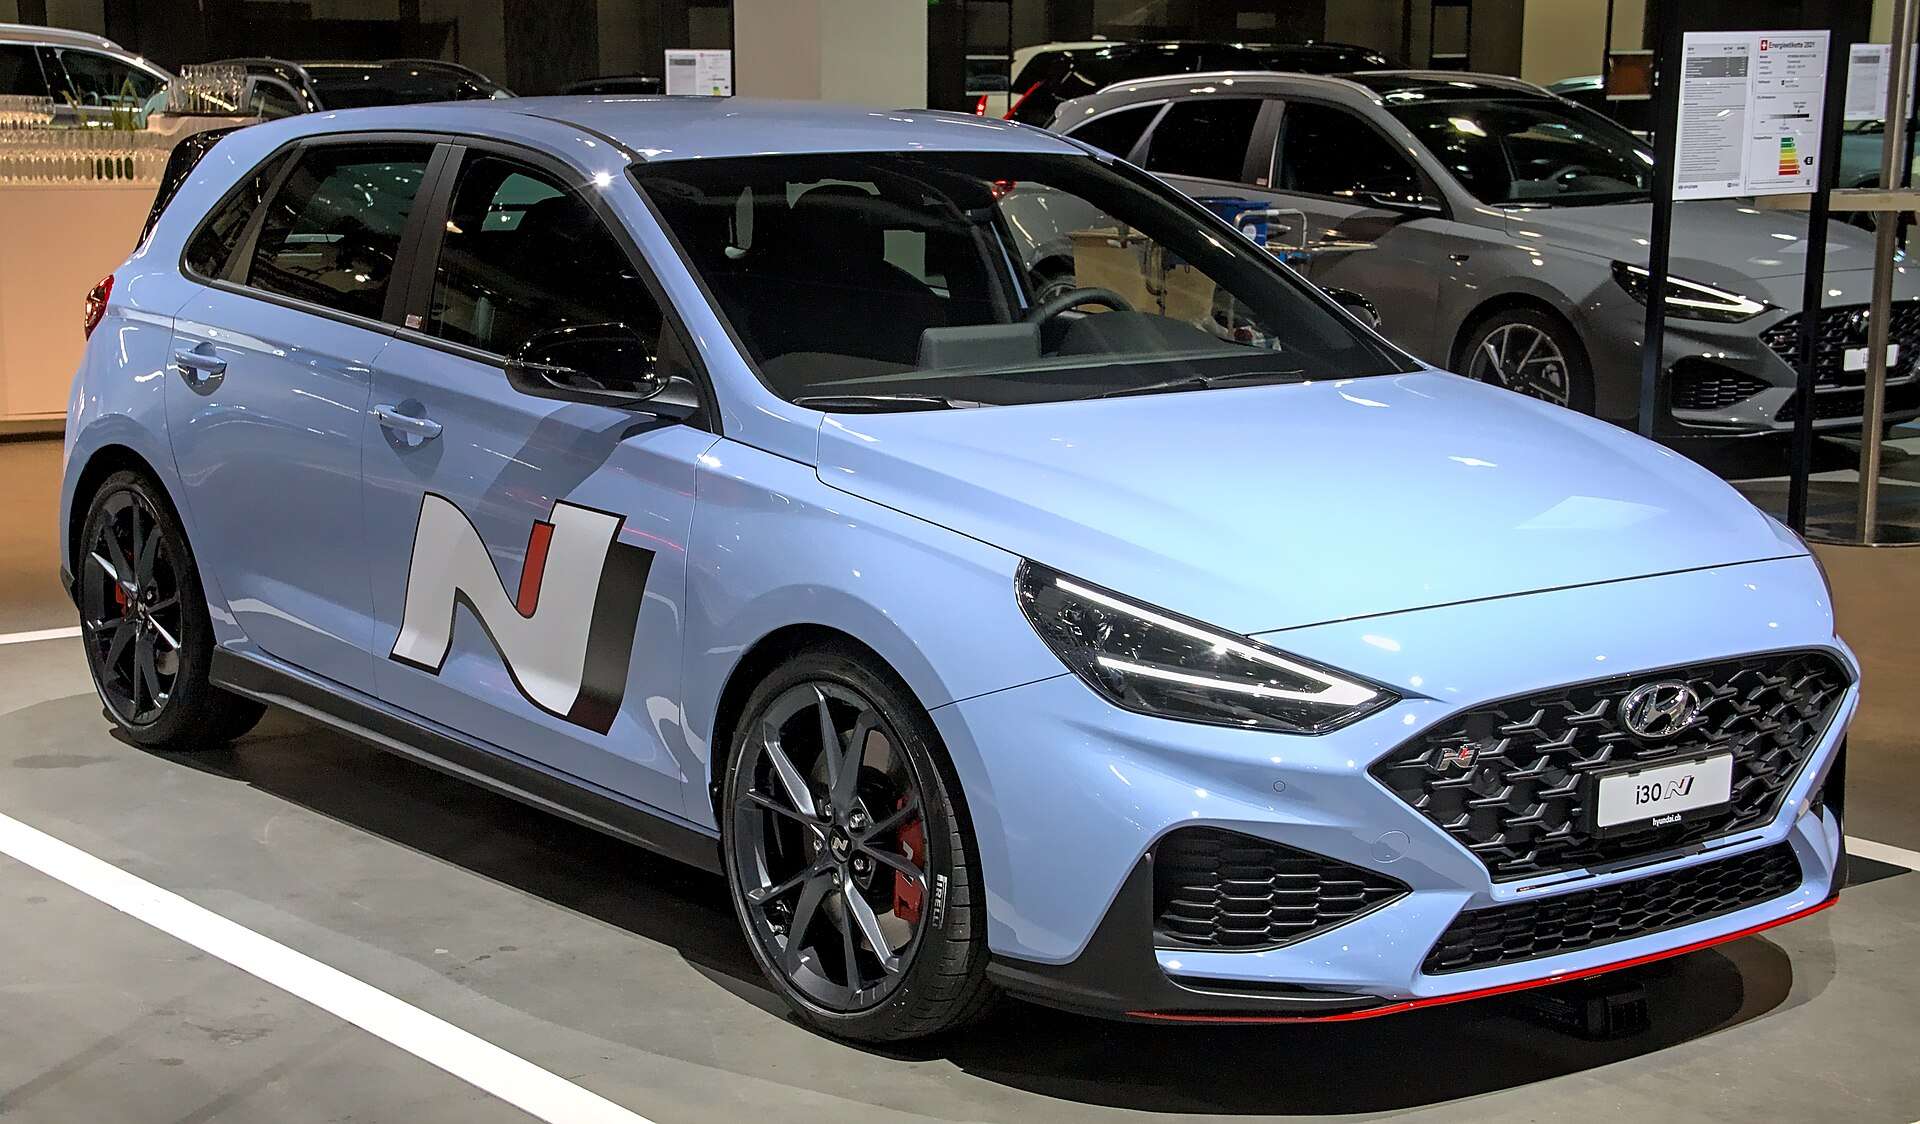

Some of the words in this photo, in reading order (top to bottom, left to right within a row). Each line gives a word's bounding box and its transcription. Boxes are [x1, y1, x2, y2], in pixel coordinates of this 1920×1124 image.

[389, 491, 656, 736] N
[1635, 782, 1662, 805] i30
[1664, 774, 1695, 800] N
[1652, 813, 1682, 827] hyundai.ch
[932, 873, 948, 930] PIRELLI
